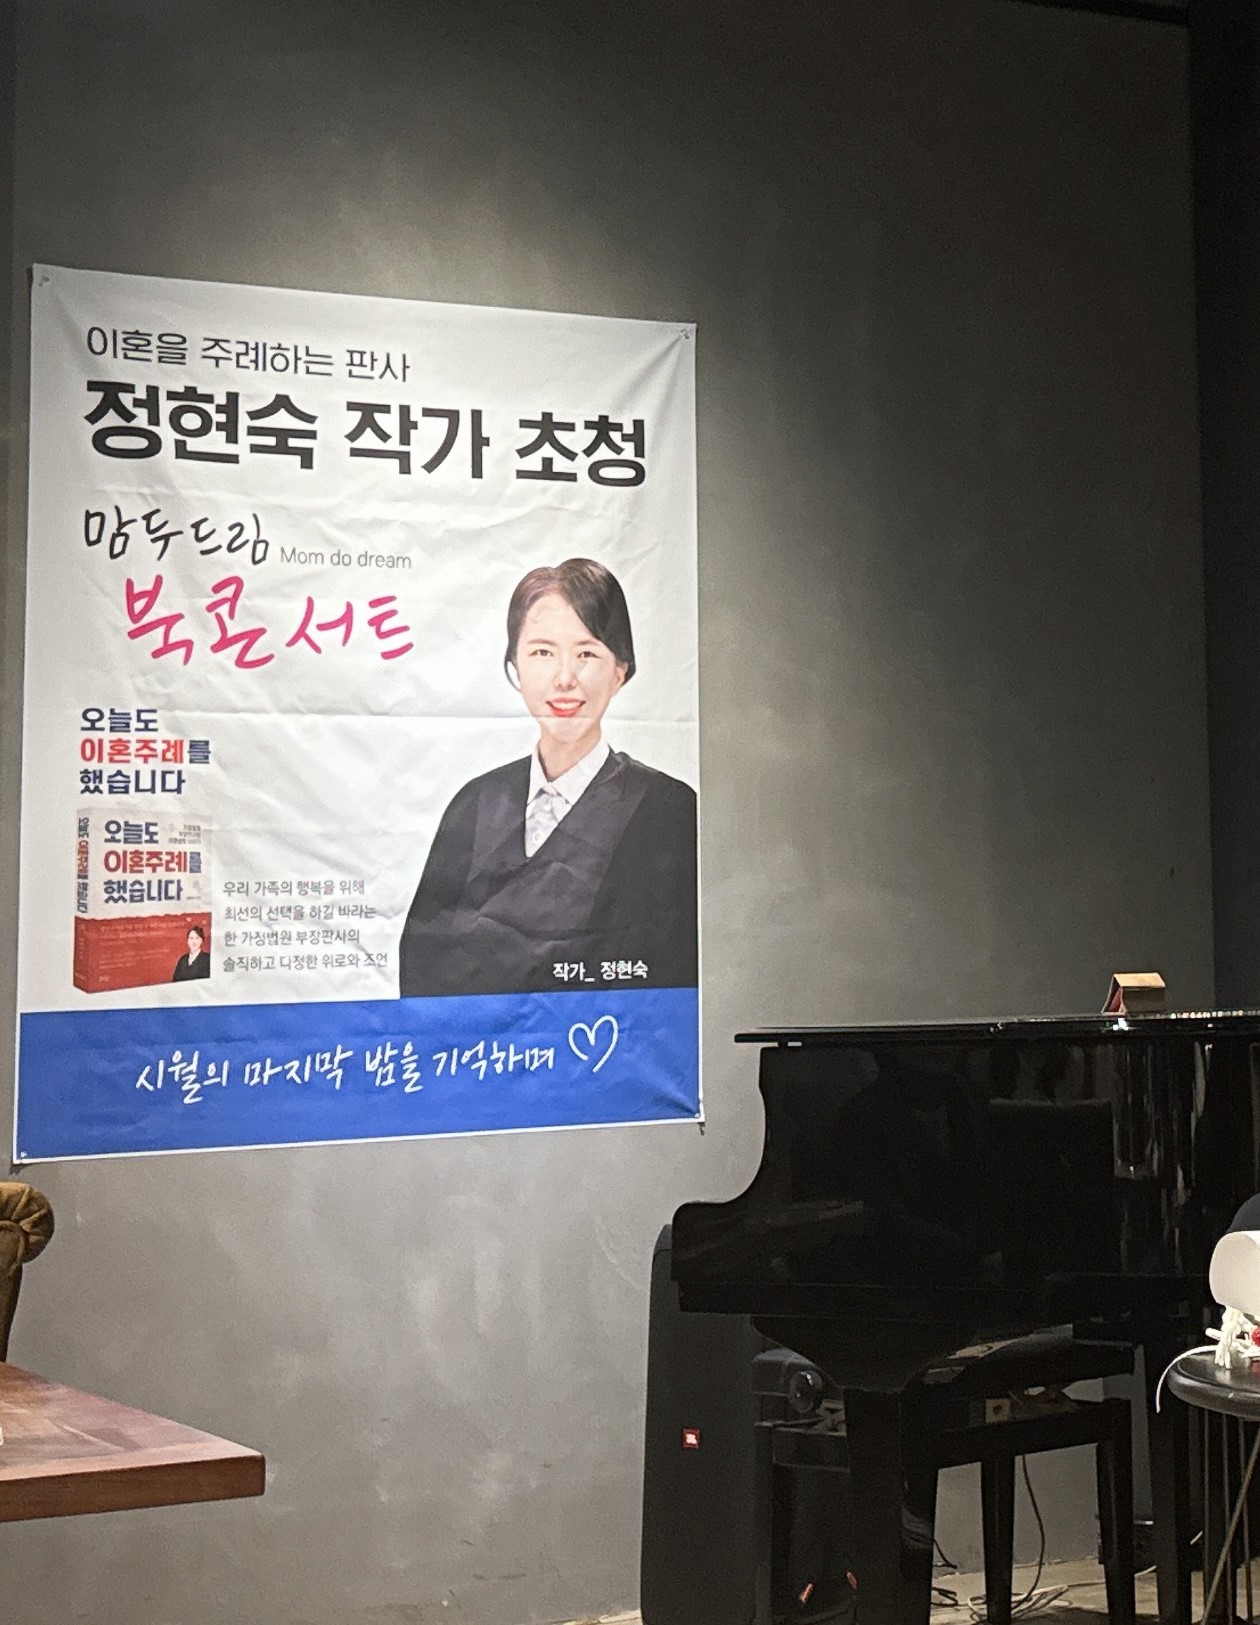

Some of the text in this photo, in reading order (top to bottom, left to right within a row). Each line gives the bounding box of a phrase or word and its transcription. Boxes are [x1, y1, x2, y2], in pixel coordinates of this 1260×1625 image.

[87, 327, 410, 384] 이혼을 주례하는 판사
[84, 380, 646, 487] 정현숙 작가 초청
[84, 505, 269, 565] 맘두드림
[280, 547, 412, 569] Mom do dream
[80, 707, 159, 733] 오늘도
[80, 738, 211, 765] 이혼주례를
[80, 769, 185, 795] 했습니다
[103, 819, 159, 845] 오늘도
[103, 849, 202, 874] 이혼주례를
[103, 879, 183, 903] 했습니다
[223, 879, 365, 897] 우리 가족의 행복을 위해
[225, 904, 376, 921] 최선의 선택을 하길 바라는
[224, 929, 360, 947] 한 가정법원 부장판사의
[223, 952, 388, 972] 솔직하고 다정한 위로와 조언
[600, 960, 649, 981] 정현숙
[135, 1040, 555, 1104] 시월의 마지막 밤을 기억하며
